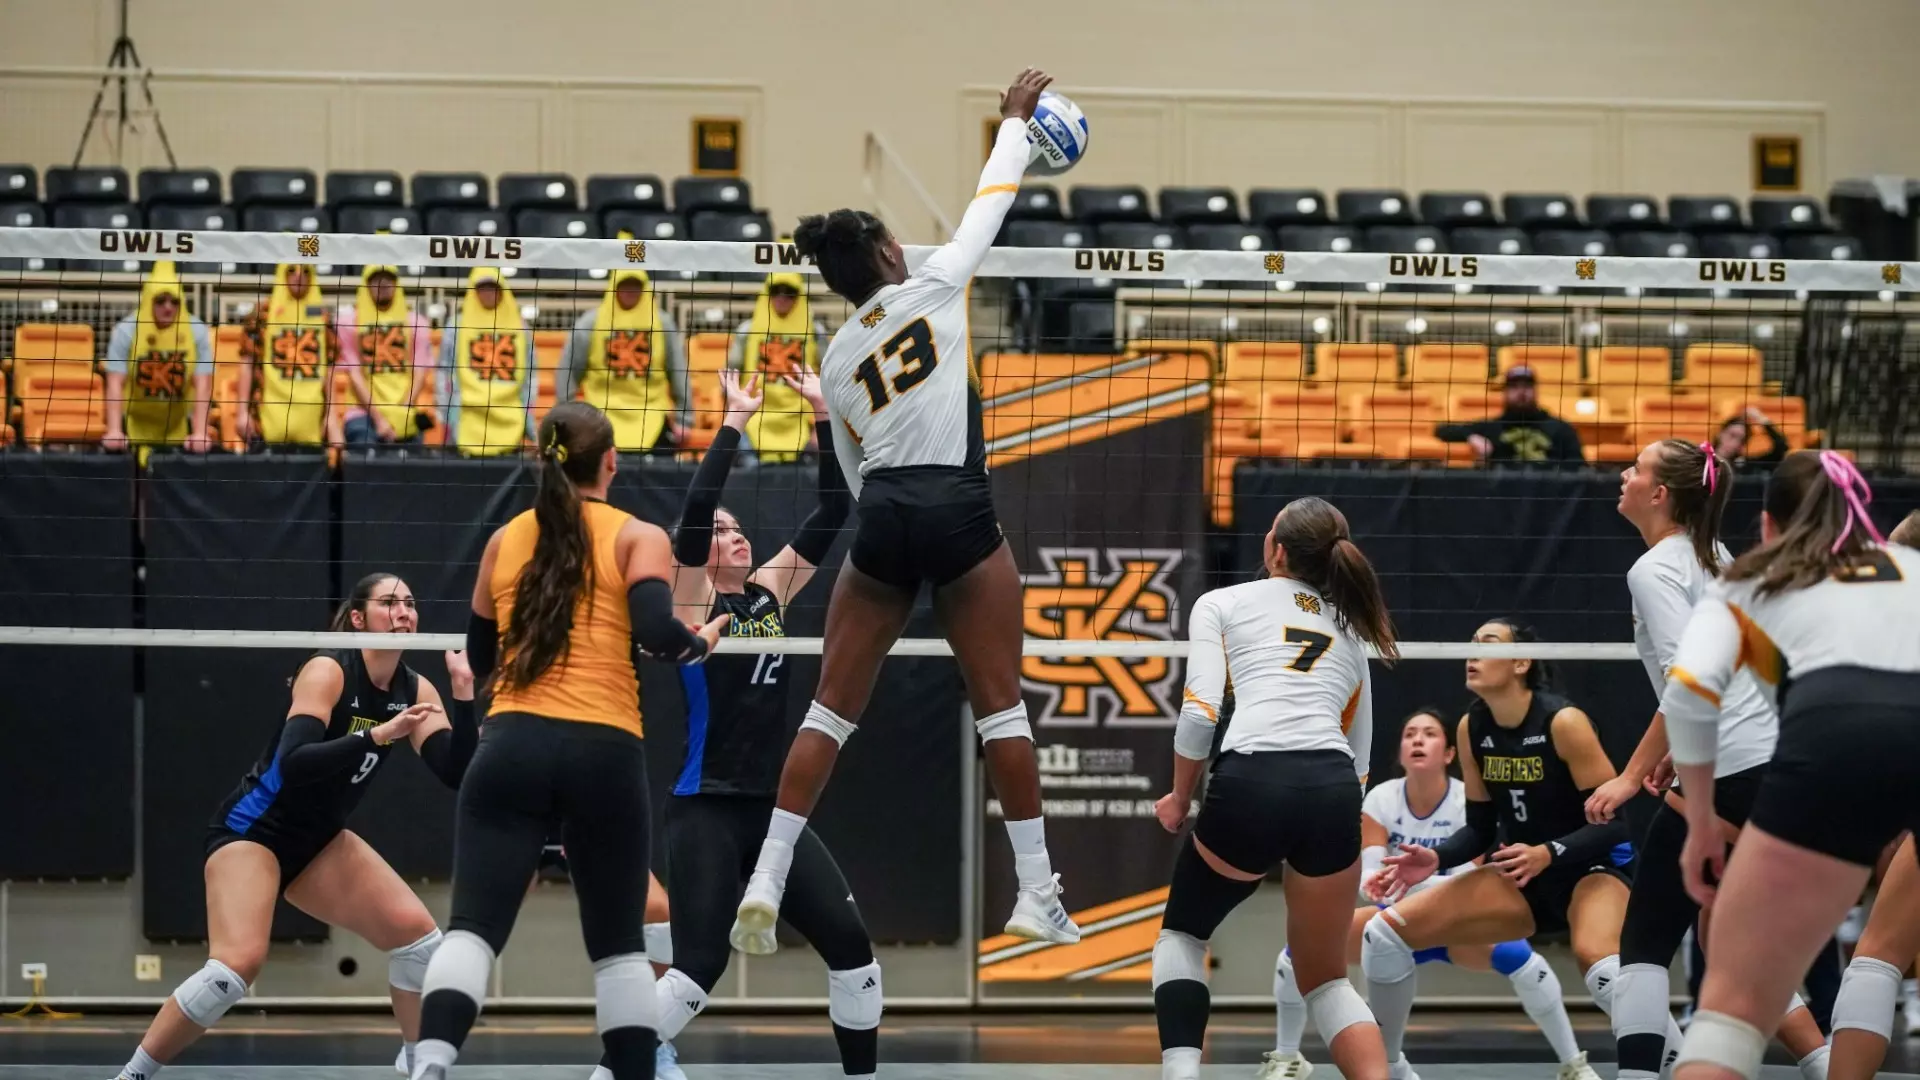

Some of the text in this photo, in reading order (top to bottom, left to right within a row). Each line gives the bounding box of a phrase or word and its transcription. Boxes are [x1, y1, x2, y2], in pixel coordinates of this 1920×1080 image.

[1027, 121, 1063, 162] molten
[100, 230, 194, 254] OWLS
[429, 236, 522, 260] OWLS
[754, 243, 818, 266] OW
[1075, 249, 1165, 272] OWLS
[1389, 255, 1479, 278] OWLS
[1700, 260, 1786, 282] OWLS
[852, 316, 940, 416] 13
[750, 652, 784, 685] 12
[1282, 625, 1335, 675] 7
[351, 752, 379, 784] 9
[1041, 799, 1087, 817] PONSOR
[1508, 789, 1528, 822] 5
